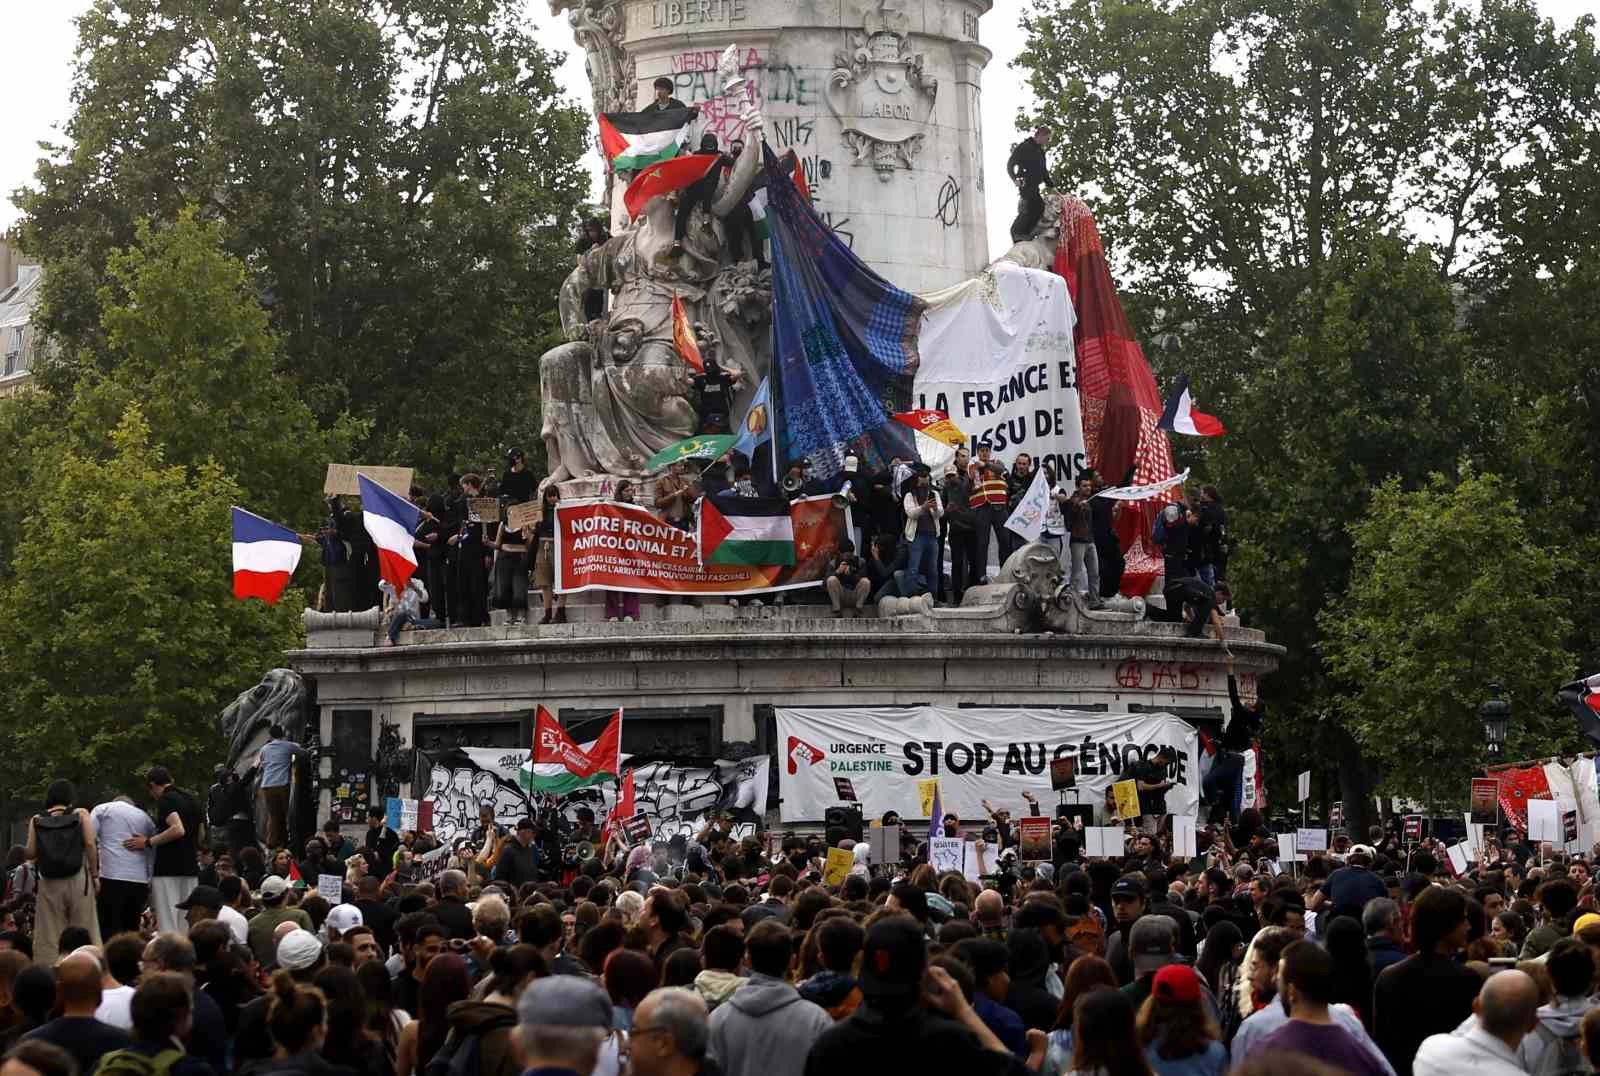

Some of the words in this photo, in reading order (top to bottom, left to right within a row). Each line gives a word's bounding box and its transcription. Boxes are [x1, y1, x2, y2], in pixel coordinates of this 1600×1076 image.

[962, 363, 1048, 418] FRANCE
[1035, 408, 1064, 438] DE
[571, 516, 620, 534] NOTRE
[623, 519, 679, 541] FRONT
[573, 534, 668, 556] ANTICOLONIAL
[671, 545, 689, 558] ET
[605, 555, 617, 564] LES
[618, 557, 651, 568] MOYENS
[647, 568, 658, 577] AU
[830, 743, 886, 754] URGENCE
[903, 742, 993, 777] STOP
[1002, 742, 1045, 776] AU
[830, 760, 893, 771] PALESTINE
